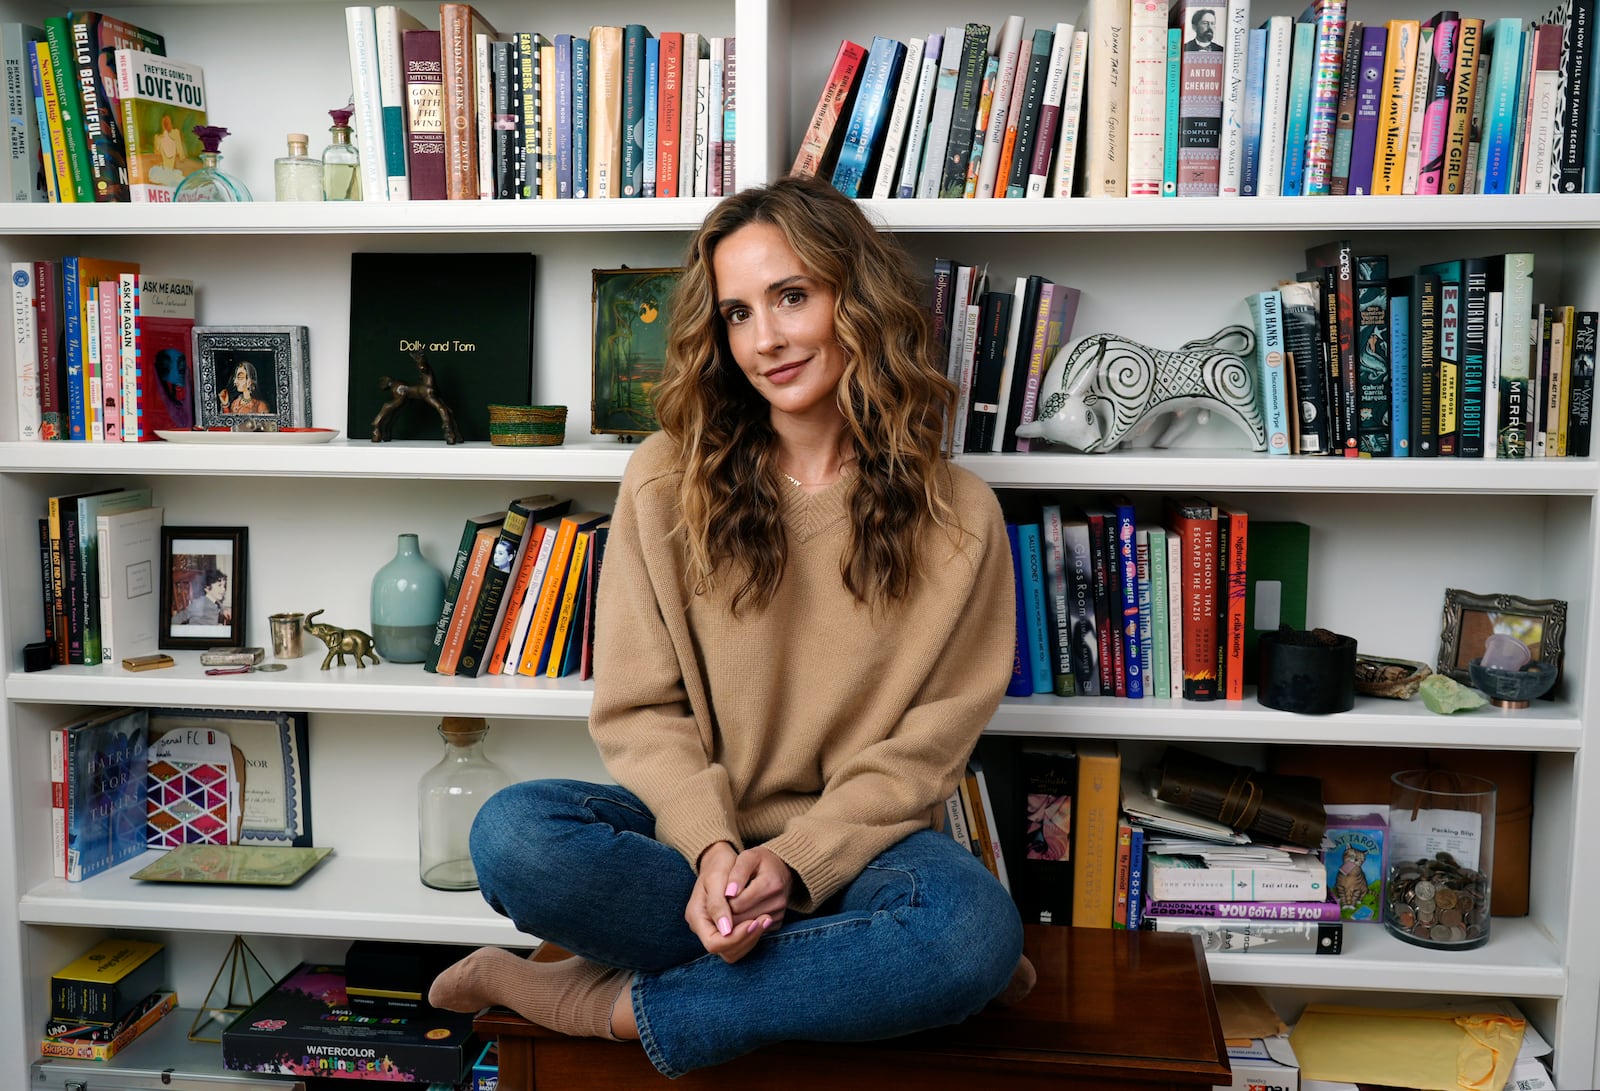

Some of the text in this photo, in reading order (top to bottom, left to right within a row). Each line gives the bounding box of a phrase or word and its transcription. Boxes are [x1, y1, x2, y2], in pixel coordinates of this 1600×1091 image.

[1110, 25, 1124, 87] DONNA TARTT
[1229, 7, 1247, 104] My Sunshine Away
[1577, 27, 1585, 49] NOW
[46, 24, 70, 107] Ambition Monster
[73, 23, 102, 140] HELLO BEAUTIFUL
[143, 63, 168, 78] THEY'RE
[168, 67, 185, 81] GOING
[186, 73, 193, 83] TO
[1000, 50, 1017, 103] Ian McEwan
[1034, 60, 1042, 73] IN
[1190, 67, 1216, 78] ANTON
[1456, 26, 1477, 114] RUTH WARE
[1575, 54, 1583, 78] SPILL
[41, 58, 60, 123] Sex and Rage
[136, 73, 202, 107] LOVE YOU
[412, 88, 441, 97] GONE
[413, 99, 441, 107] WITH
[521, 33, 537, 154] EASY RIDERS, RAGING BULLS
[577, 45, 585, 129] THE LAST OF THE JUST
[665, 39, 677, 132] The PARIS Architect
[1027, 79, 1039, 110] COLD
[1184, 81, 1219, 91] CHEKHOV
[1574, 79, 1582, 95] THE
[413, 119, 442, 127] WIND
[417, 109, 437, 117] THE
[992, 107, 1006, 144] Nutshell
[1383, 66, 1407, 182] The Love Machine
[1571, 98, 1581, 127] FAMILY
[625, 124, 635, 178] Molly Ringwald
[1020, 115, 1032, 153] BLOOD
[1453, 132, 1465, 146] IT
[1569, 128, 1578, 163] SECRETS
[148, 188, 171, 203] MEG
[1340, 246, 1352, 280] torso
[142, 280, 194, 297] ASK ME AGAIN
[935, 269, 949, 314] Hollywood
[1469, 271, 1488, 293] THE
[15, 290, 27, 344] GIDEON
[124, 279, 133, 347] ASK ME AGAIN
[1265, 295, 1279, 347] TOM HANKS
[1466, 295, 1487, 345] TURNOUT
[1511, 257, 1527, 351] ANNE RICE
[103, 292, 114, 389] JUST LIKE HOME
[1030, 297, 1051, 376] THE CRANE WIFE
[1328, 293, 1340, 377] DIRECTING GREAT TELEVISION
[1442, 289, 1458, 357] MAMET
[1575, 329, 1585, 351] RICE
[1583, 325, 1595, 353] ANNE
[399, 339, 476, 352] Dolly and Tom
[42, 327, 52, 407] THE PIANO TEACHER
[1465, 353, 1485, 393] MEGAN
[1272, 371, 1282, 428] Uncommon Type
[1462, 398, 1483, 438] ABBOTT
[1507, 380, 1523, 455] MERRICK
[1572, 388, 1583, 416] LESTAT
[1580, 387, 1592, 426] VAMPIRE
[471, 538, 492, 578] Educated
[1028, 534, 1040, 583] SALLY ROONEY
[1205, 531, 1213, 549] THE
[1123, 517, 1135, 603] SOMEBODY'S DAUGHTER
[1194, 526, 1202, 621] ESCAPED THE NAZIS
[1074, 542, 1090, 616] Glass Room
[1155, 547, 1165, 624] SEA OF TRANQUILITY
[472, 576, 505, 652] ENCHANTMENT
[87, 744, 143, 774] HATRED
[101, 774, 128, 793] FOR
[90, 793, 139, 820] TULIPS
[949, 798, 967, 839] Plain and
[1334, 835, 1345, 847] AT
[1349, 834, 1378, 852] TAROT
[1431, 827, 1459, 836] Packing
[1150, 908, 1216, 917] GOODMAN
[1151, 902, 1216, 912] BRANDON KYLE
[1218, 904, 1322, 920] YOU GOTTA BE YOU
[48, 1024, 67, 1036] UNO
[301, 1055, 381, 1073] Painting Set
[306, 1044, 376, 1059] WATERCOLOR
